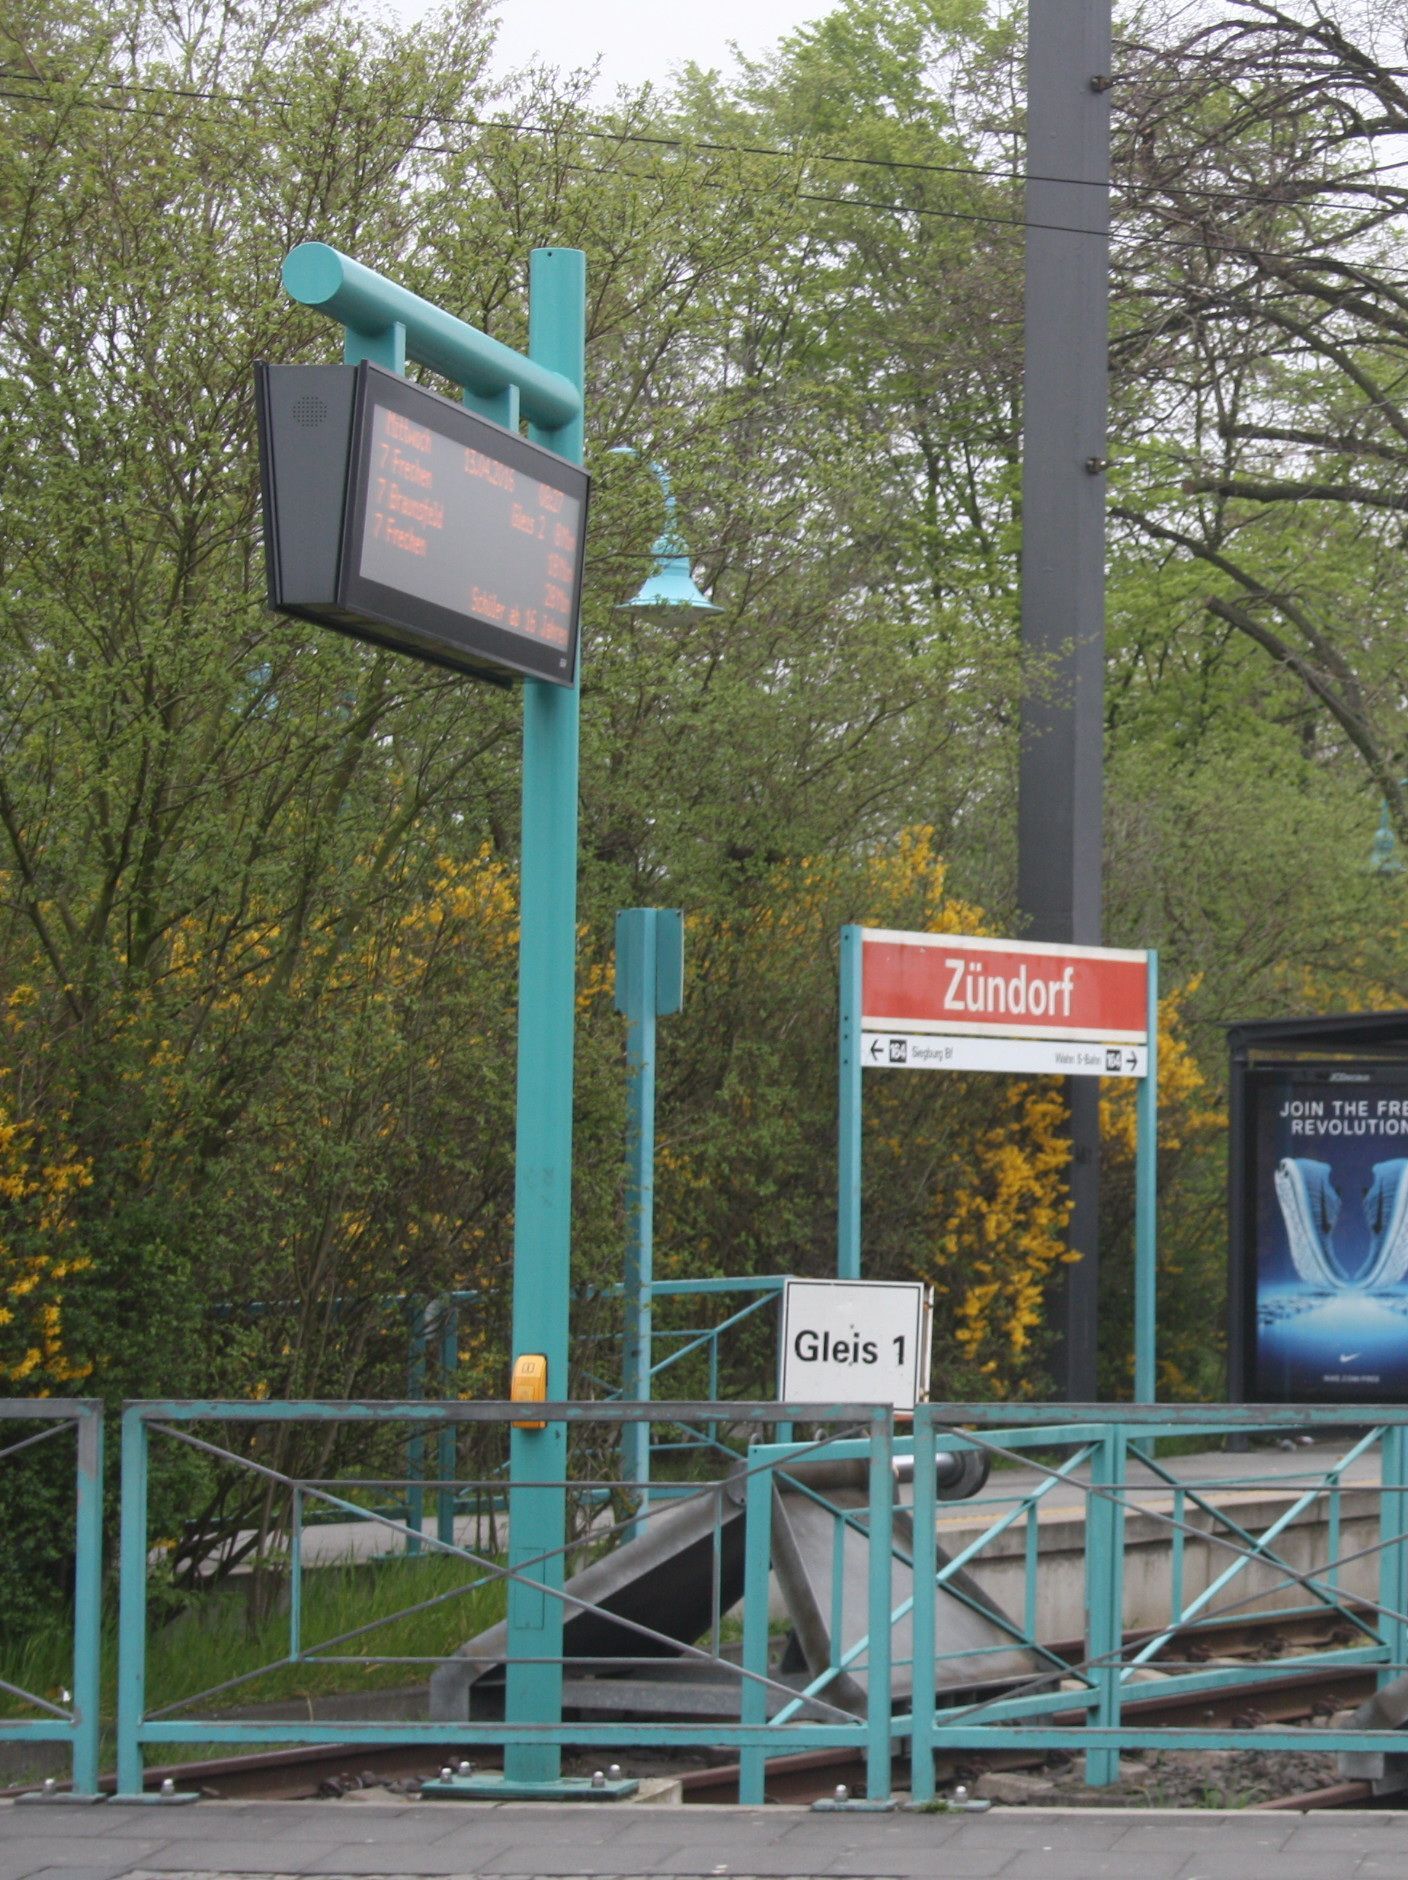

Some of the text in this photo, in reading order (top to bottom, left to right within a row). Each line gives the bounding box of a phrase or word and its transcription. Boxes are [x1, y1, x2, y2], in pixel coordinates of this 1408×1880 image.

[943, 958, 1074, 1017] Zündorf
[1280, 1101, 1324, 1117] JOIN
[1332, 1101, 1369, 1117] THE
[794, 1330, 905, 1365] Gleis 1
